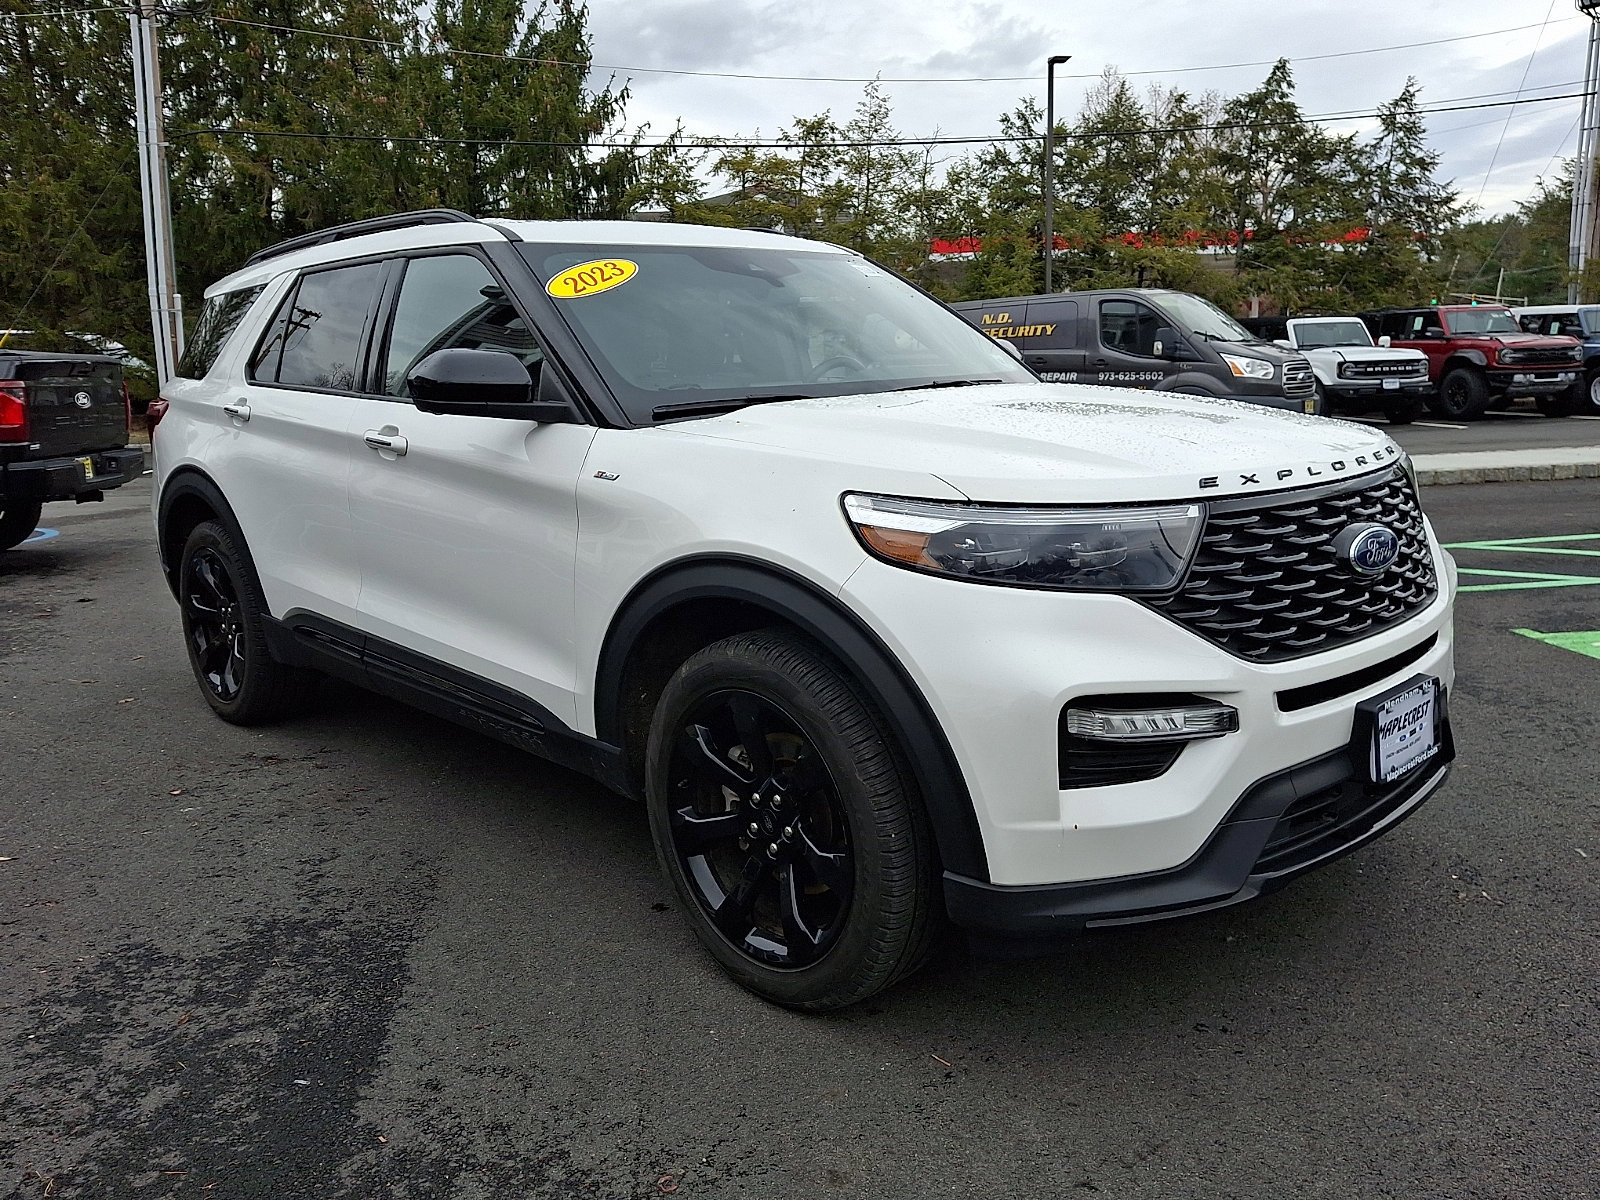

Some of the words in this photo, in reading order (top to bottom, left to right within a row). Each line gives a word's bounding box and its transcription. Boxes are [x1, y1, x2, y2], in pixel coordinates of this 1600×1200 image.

[563, 262, 625, 294] 2023
[981, 313, 1012, 325] N.D.
[982, 324, 1057, 339] SECURITY
[1040, 372, 1078, 381] REPAIR
[1098, 371, 1164, 381] 973-625-5602
[1199, 445, 1395, 489] EXPLORER
[1422, 680, 1432, 689] NJ
[1379, 699, 1431, 740] MAPLECREST
